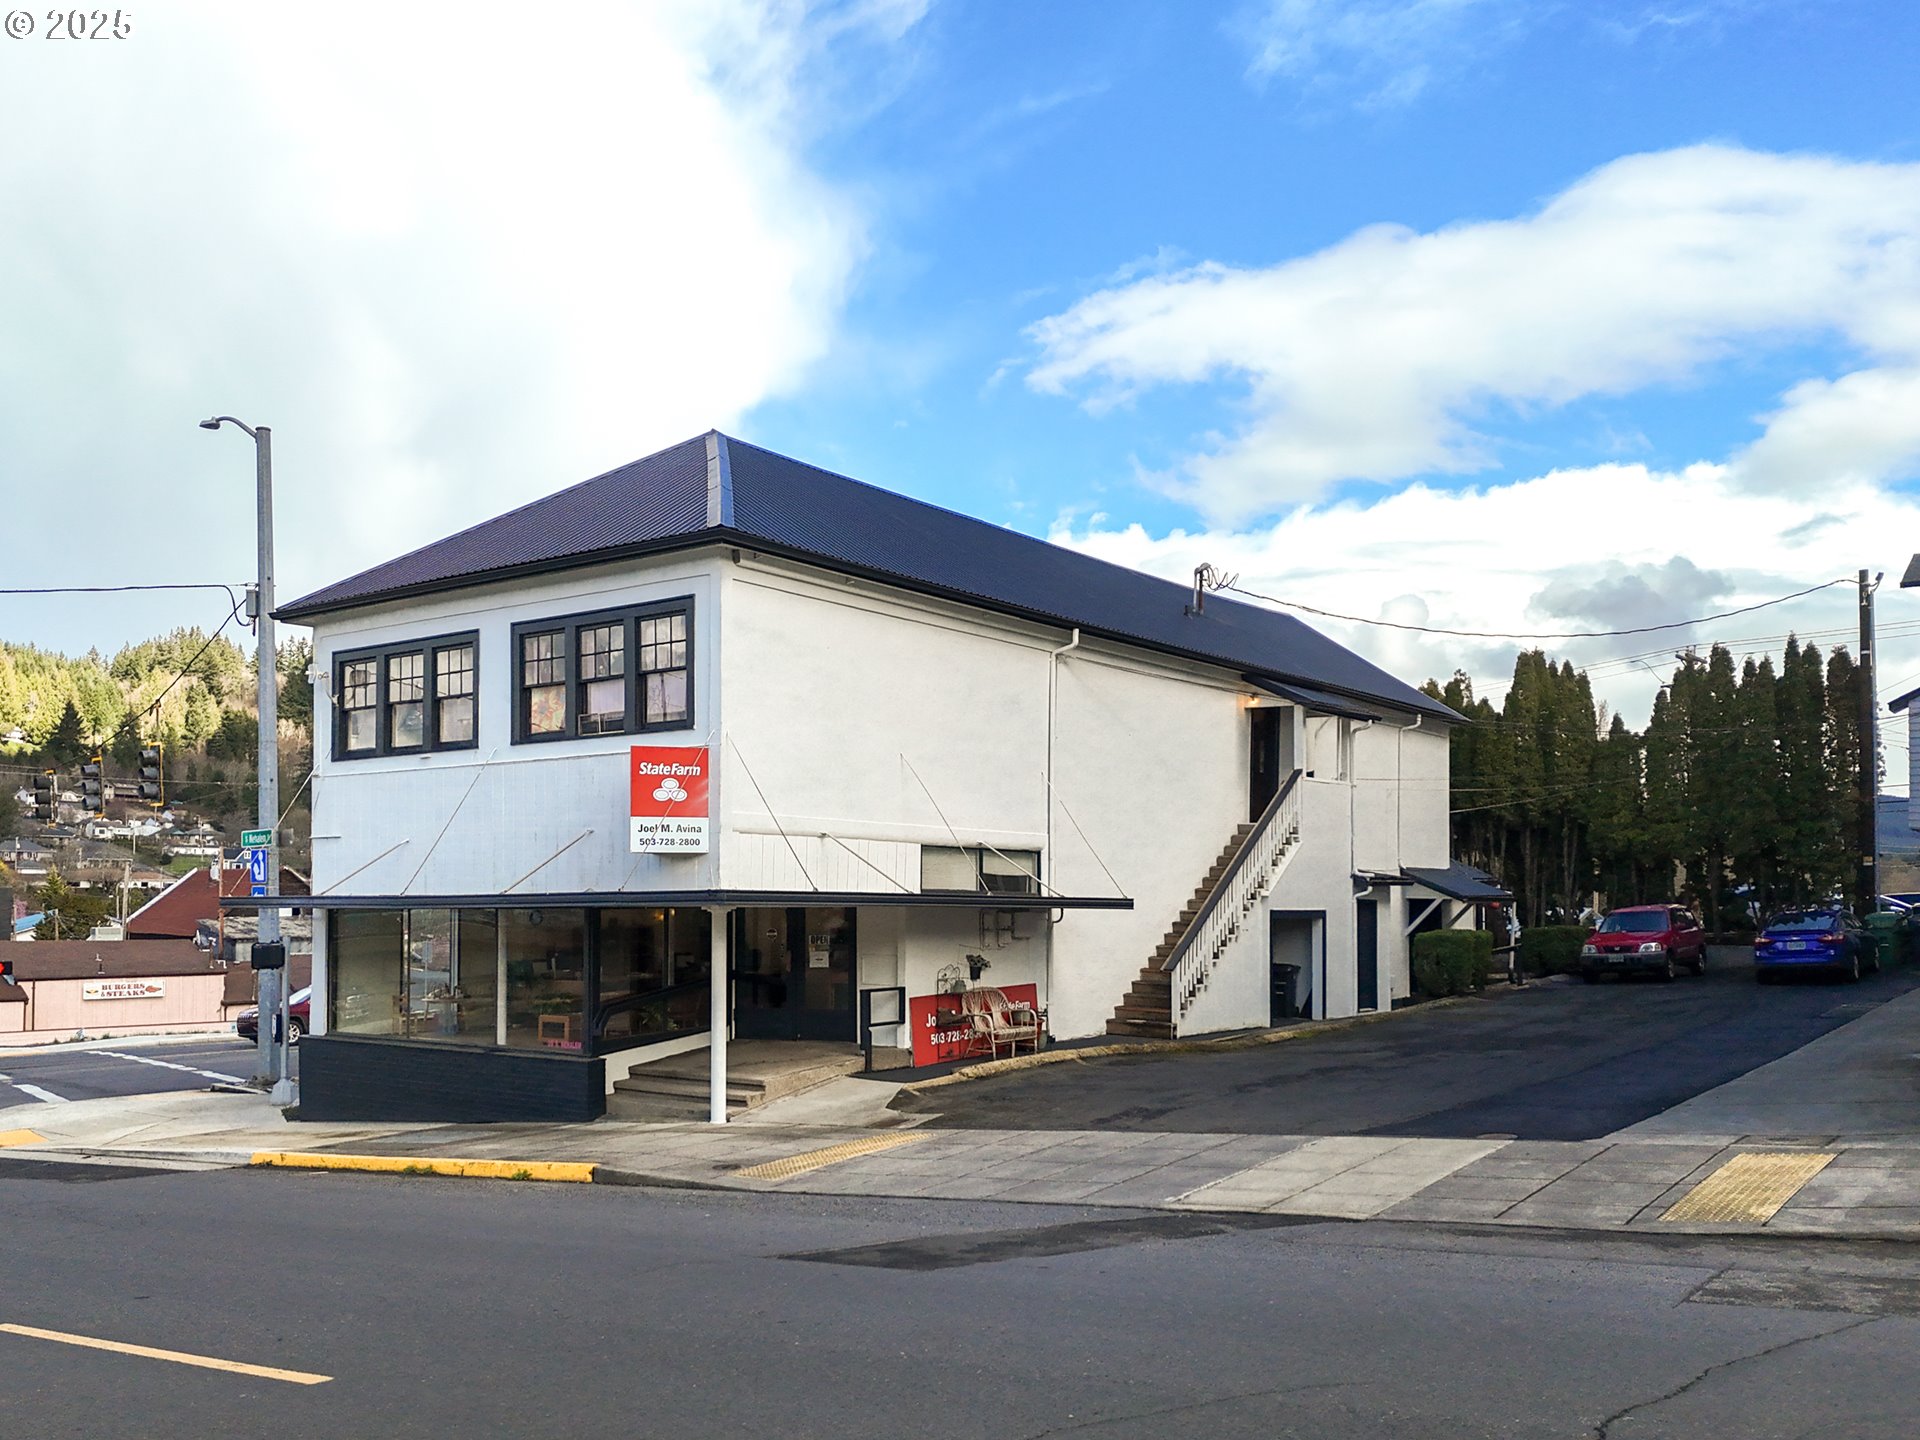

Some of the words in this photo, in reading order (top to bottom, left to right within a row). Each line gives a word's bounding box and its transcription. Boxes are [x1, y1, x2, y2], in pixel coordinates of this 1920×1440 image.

[638, 824, 658, 833] Joel
[661, 824, 673, 833] M.
[676, 824, 702, 833] Avina
[639, 838, 701, 846] 503-728-2800
[102, 983, 145, 991] BURGERS
[930, 1029, 983, 1046] 503-728-28
